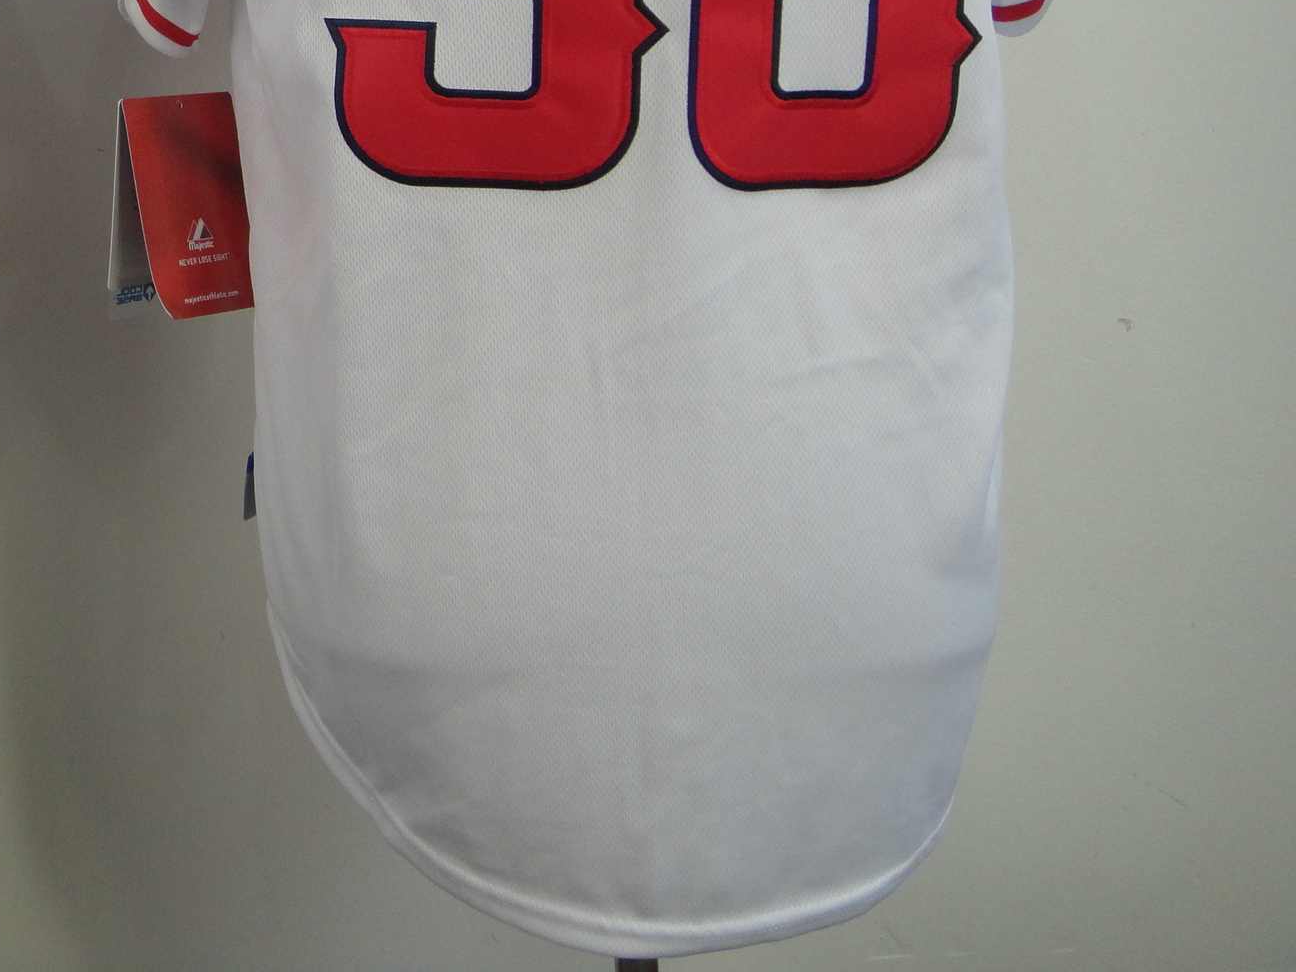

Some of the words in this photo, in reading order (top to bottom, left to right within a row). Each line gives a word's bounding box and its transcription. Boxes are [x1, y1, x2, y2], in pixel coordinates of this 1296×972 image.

[189, 241, 214, 251] Majestic
[179, 257, 197, 266] NEVER
[198, 255, 212, 263] LOSE
[185, 290, 238, 304] majesticathletic.com
